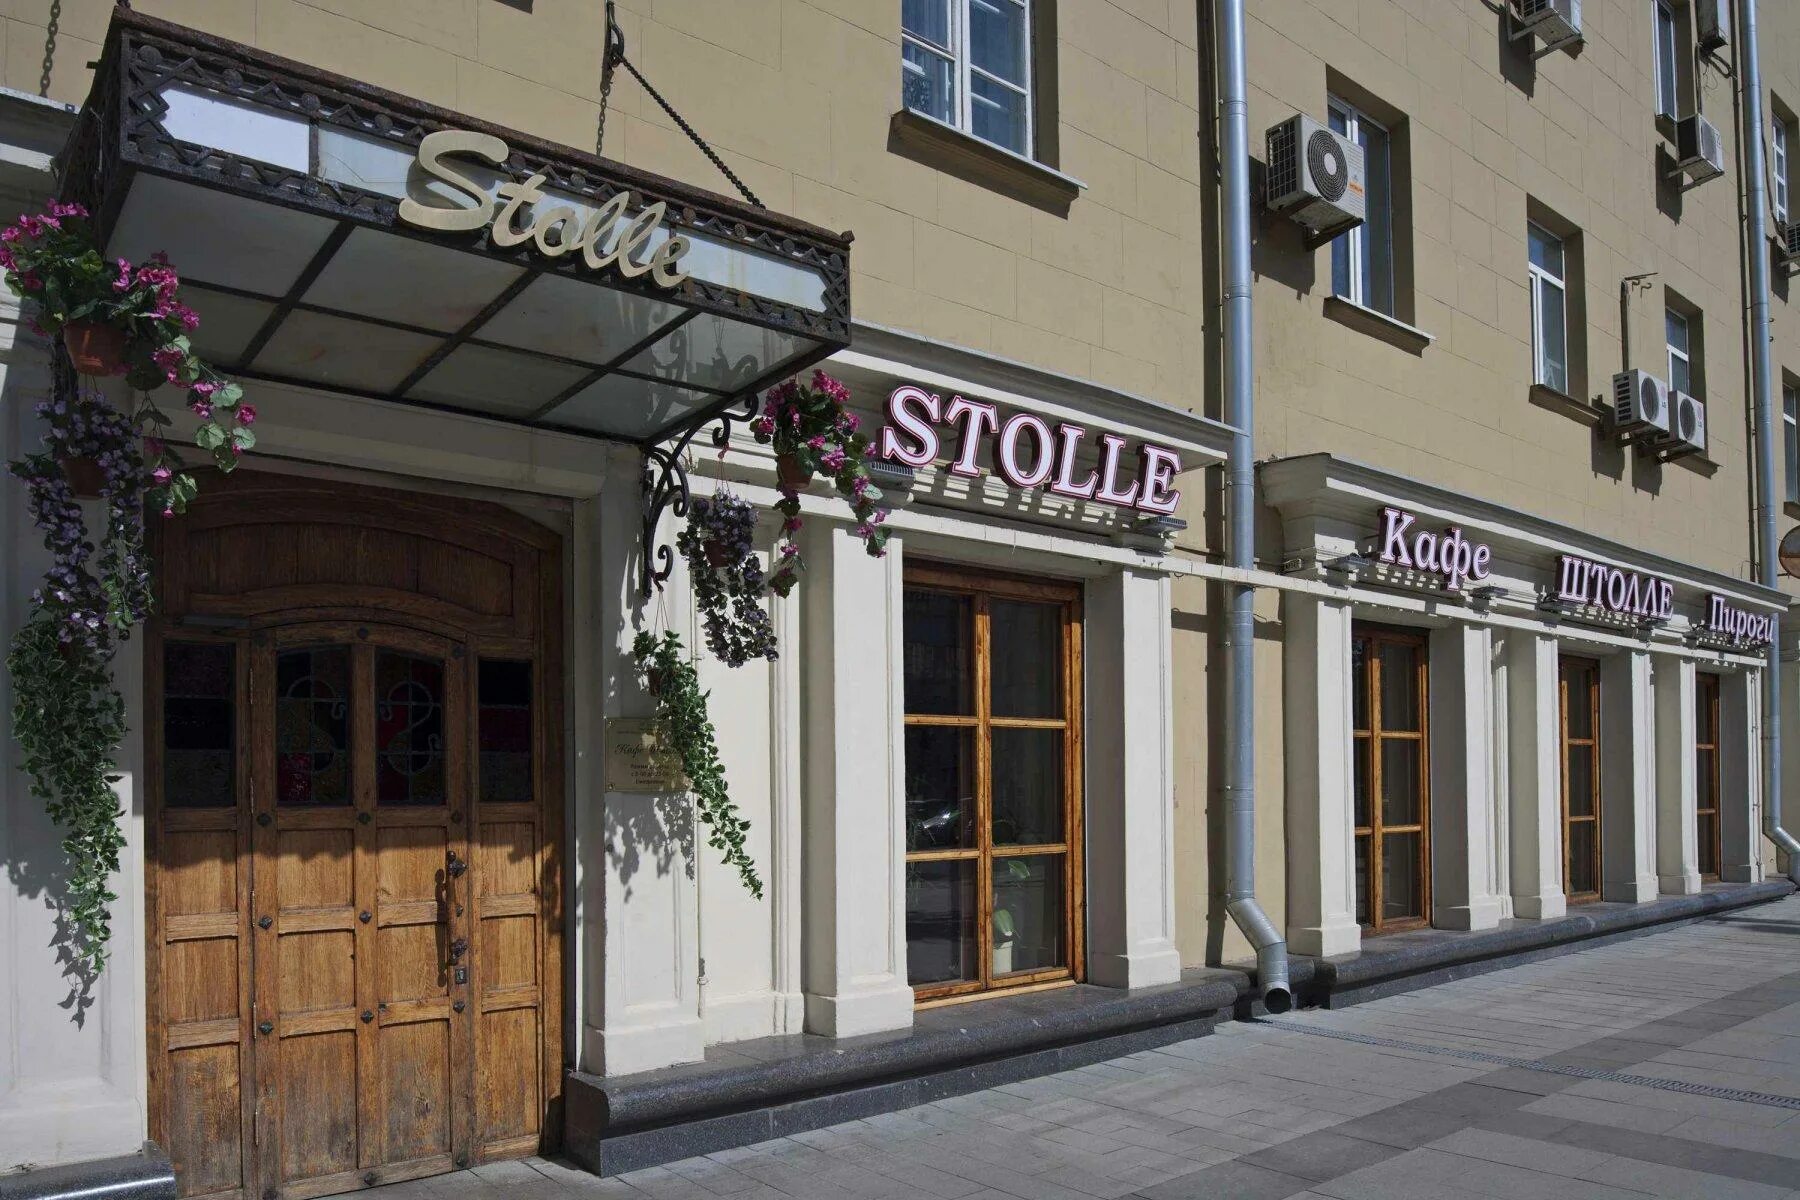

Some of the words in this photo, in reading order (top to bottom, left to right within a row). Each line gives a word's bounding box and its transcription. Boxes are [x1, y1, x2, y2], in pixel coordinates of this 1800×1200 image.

[399, 130, 691, 288] Stolle
[882, 385, 1183, 515] STOLLE
[1379, 507, 1491, 592] Кафе
[1557, 555, 1675, 621] ШТОЛЛЕ
[1709, 594, 1774, 647] Пироги
